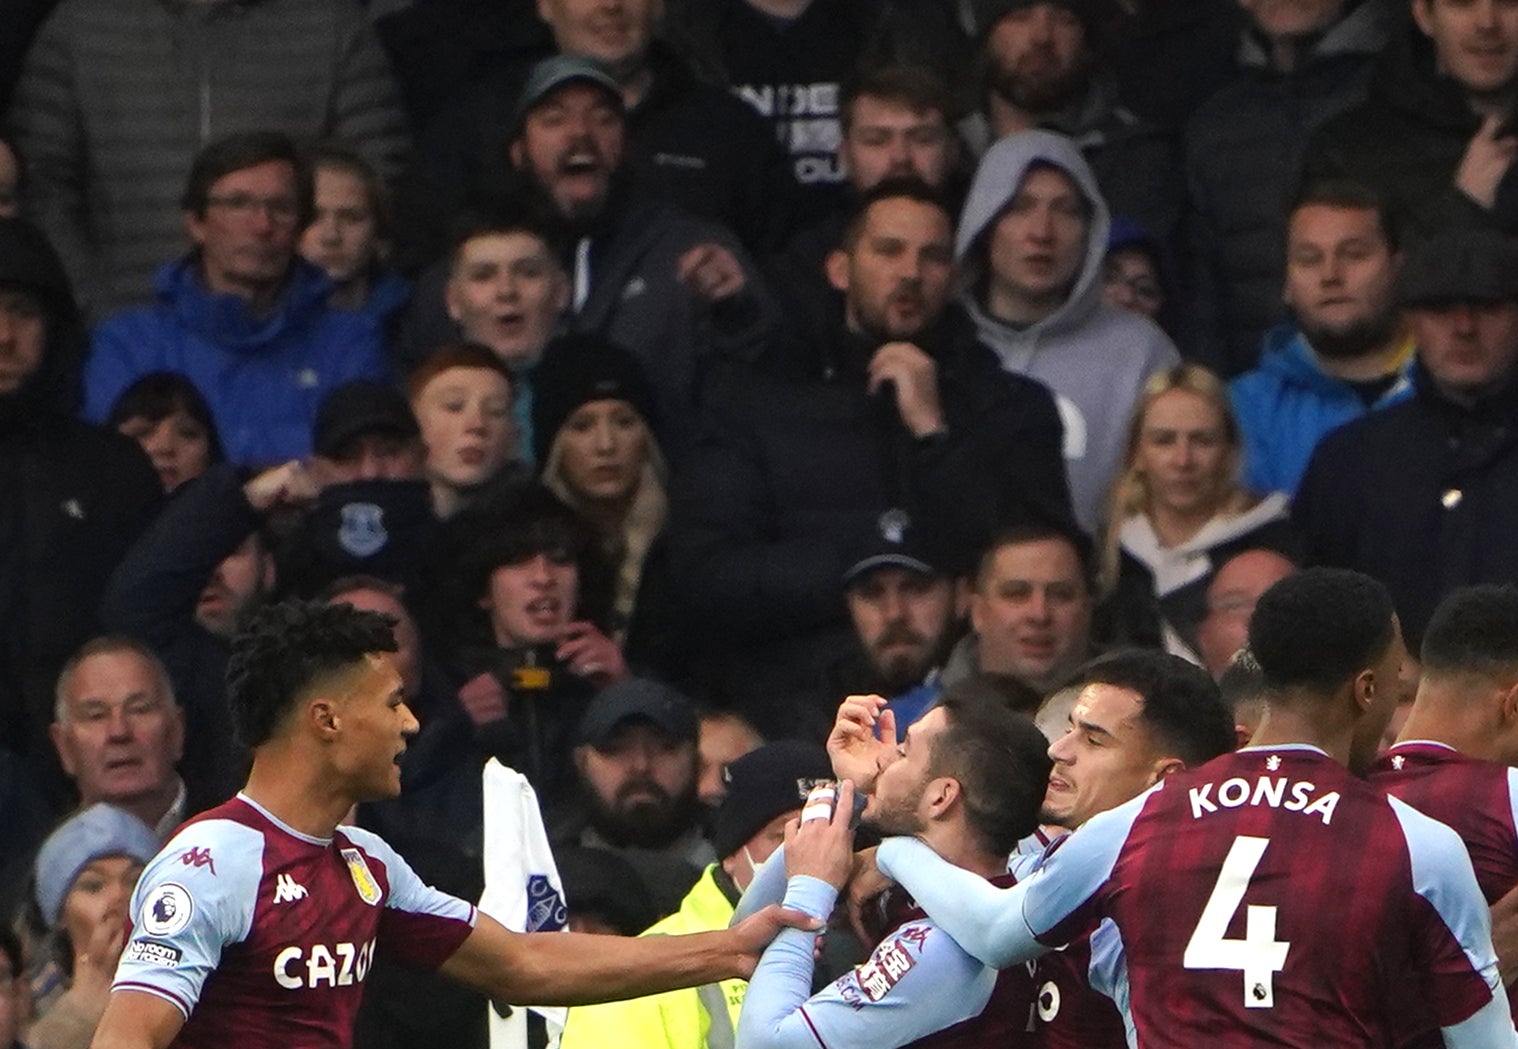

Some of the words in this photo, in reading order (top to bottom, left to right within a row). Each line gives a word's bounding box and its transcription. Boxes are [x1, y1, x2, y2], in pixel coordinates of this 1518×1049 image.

[1188, 776, 1340, 825] KONSA
[1183, 835, 1290, 1008] 4
[274, 936, 377, 989] CAZO
